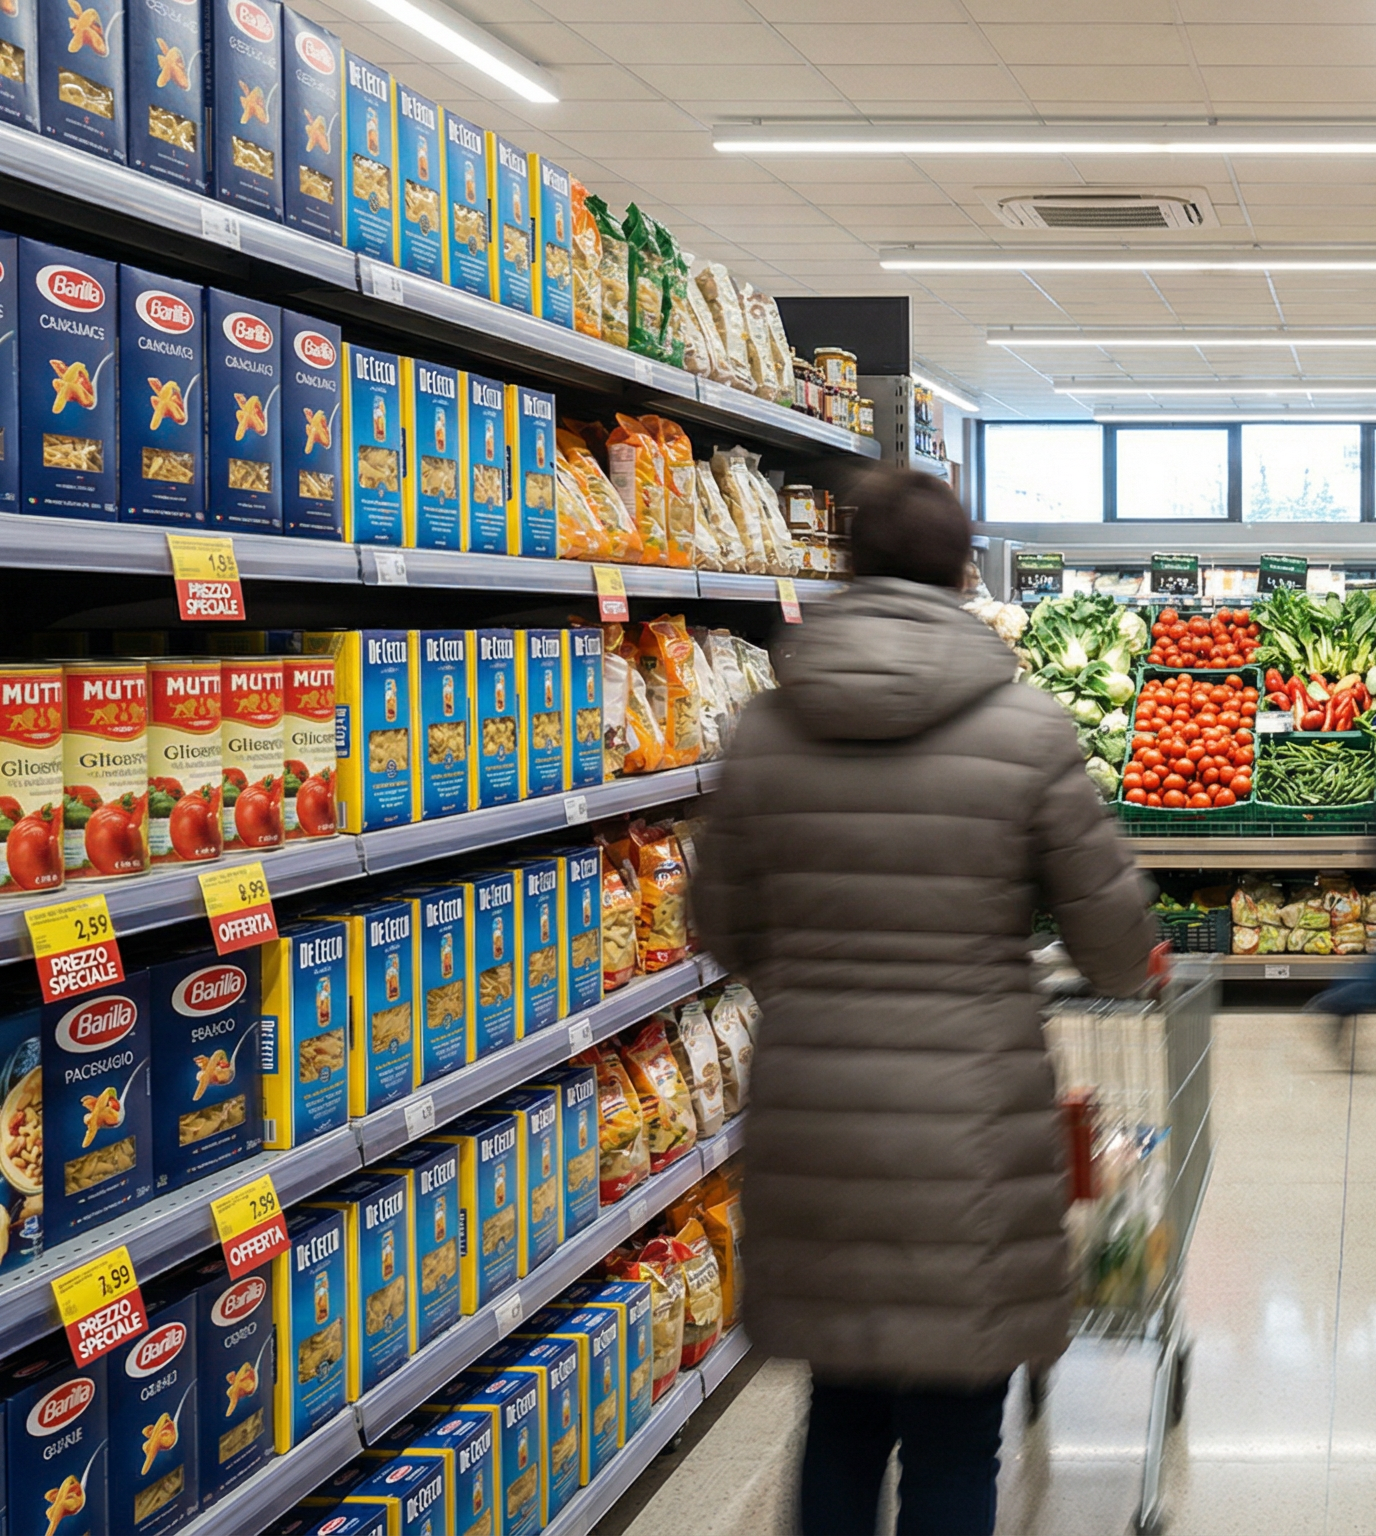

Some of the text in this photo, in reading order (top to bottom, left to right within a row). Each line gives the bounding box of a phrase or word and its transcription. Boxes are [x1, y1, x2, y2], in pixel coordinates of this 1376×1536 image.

[53, 275, 100, 303] Barilla
[150, 299, 190, 326] Barilla
[83, 679, 146, 700] MUTT
[167, 675, 220, 696] MUTT
[231, 672, 283, 692] MUTT
[293, 670, 334, 687] MUTT
[3, 682, 61, 705] MUTT
[74, 914, 108, 942] 2,59
[219, 913, 273, 942] OFFERTA
[51, 947, 108, 976] PREZZO
[49, 962, 118, 995] SPECIALE
[191, 975, 241, 1002] Barilla
[77, 1007, 132, 1039] Barilla
[230, 1225, 285, 1266] OFFERTA
[78, 1299, 131, 1339] PREZZO
[79, 1312, 142, 1358] SPECIALE
